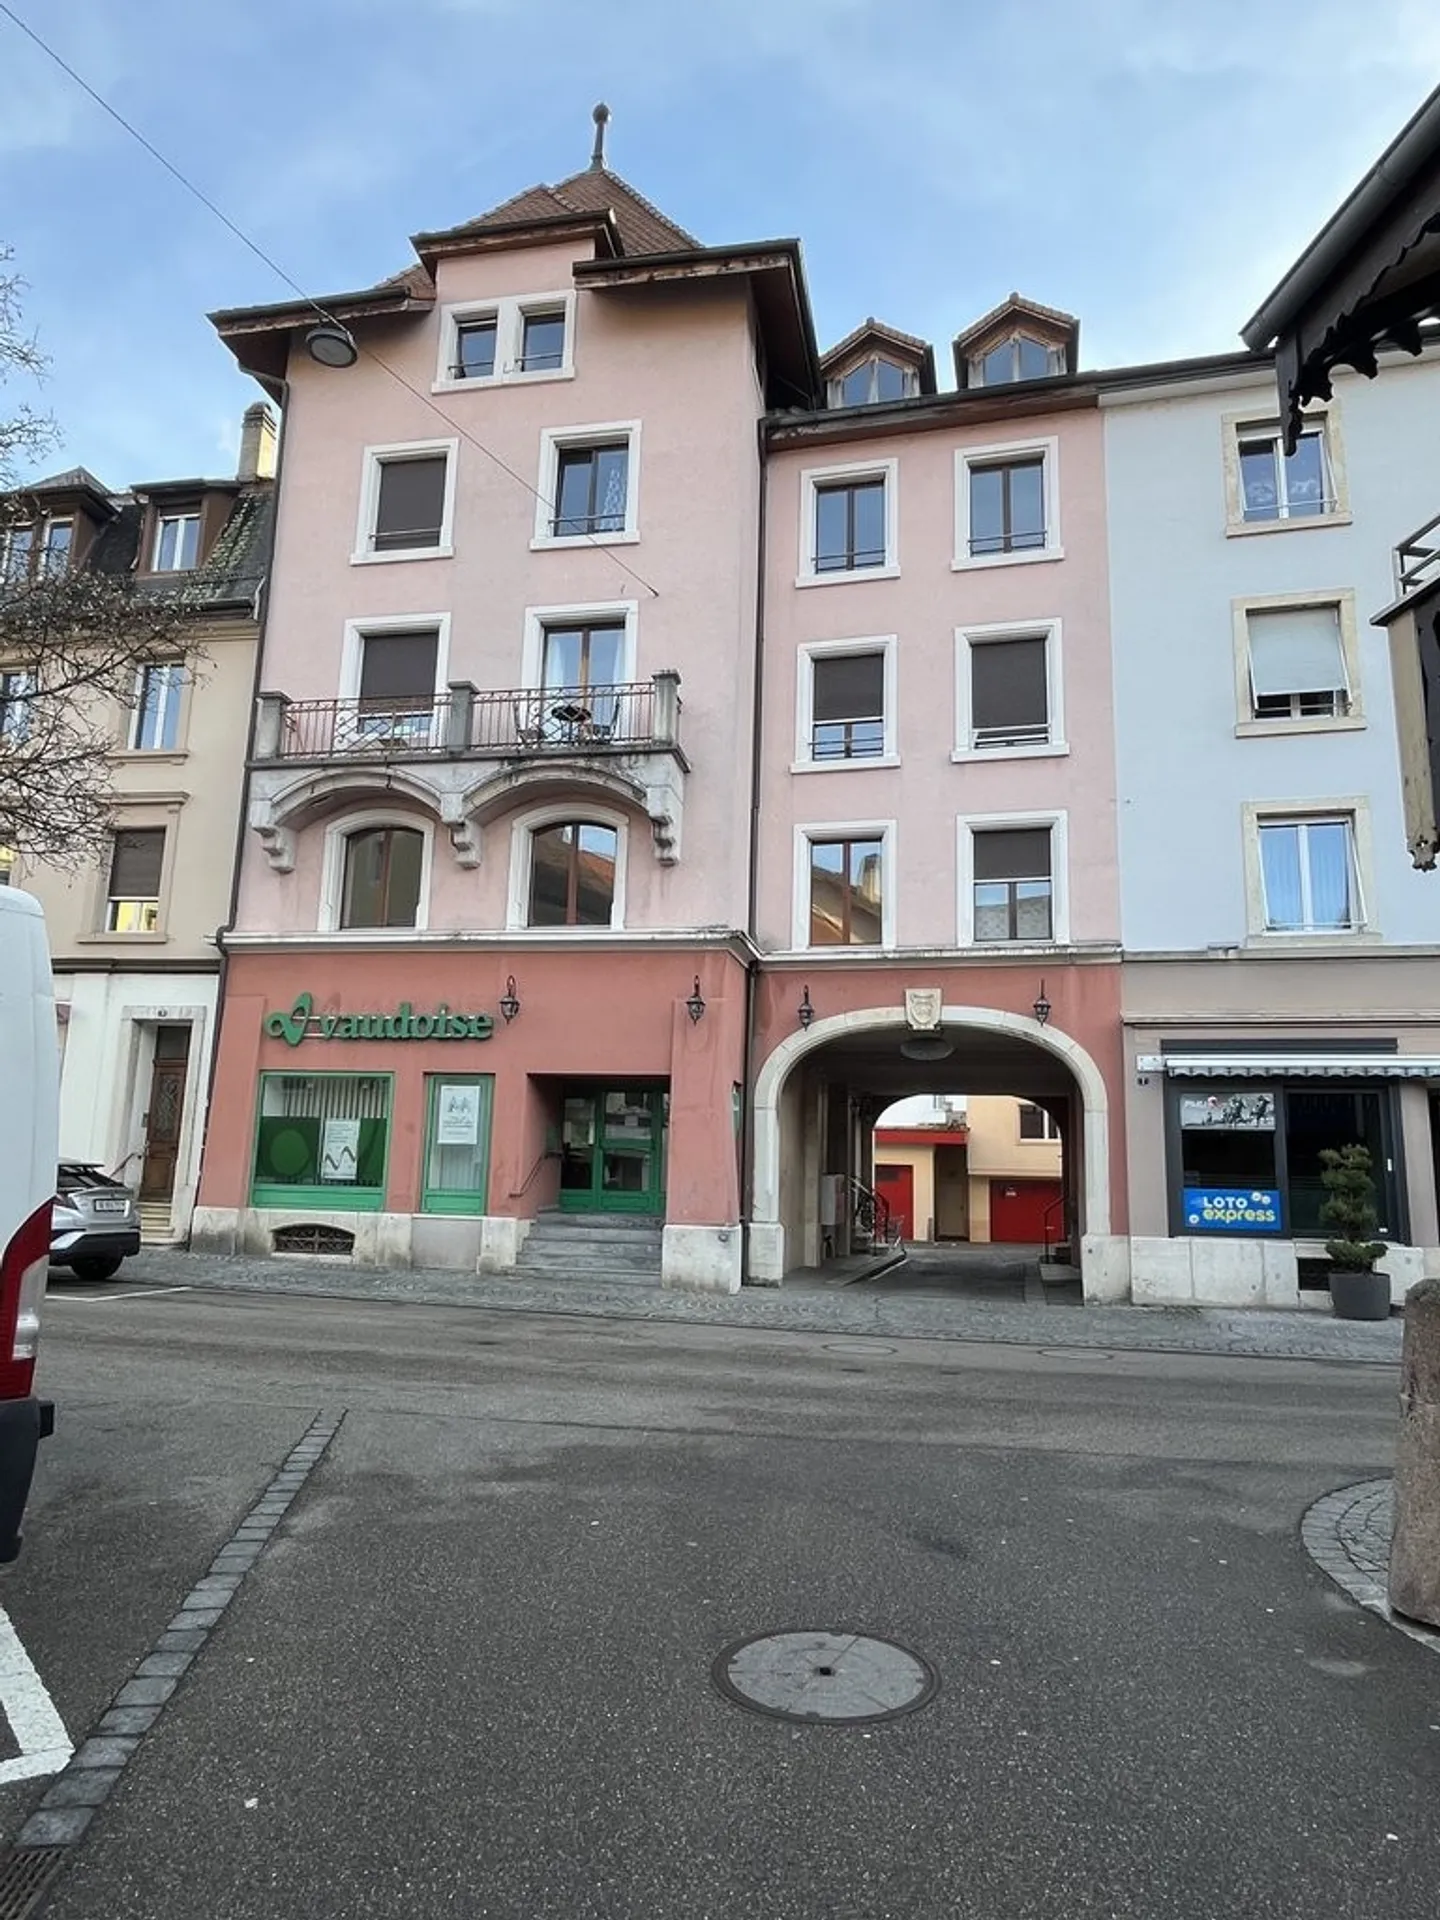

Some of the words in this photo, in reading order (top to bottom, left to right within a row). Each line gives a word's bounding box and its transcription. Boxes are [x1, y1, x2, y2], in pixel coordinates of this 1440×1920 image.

[319, 1002, 493, 1039] vaudoise
[1203, 1196, 1248, 1209] LOTO
[1203, 1209, 1275, 1224] express
